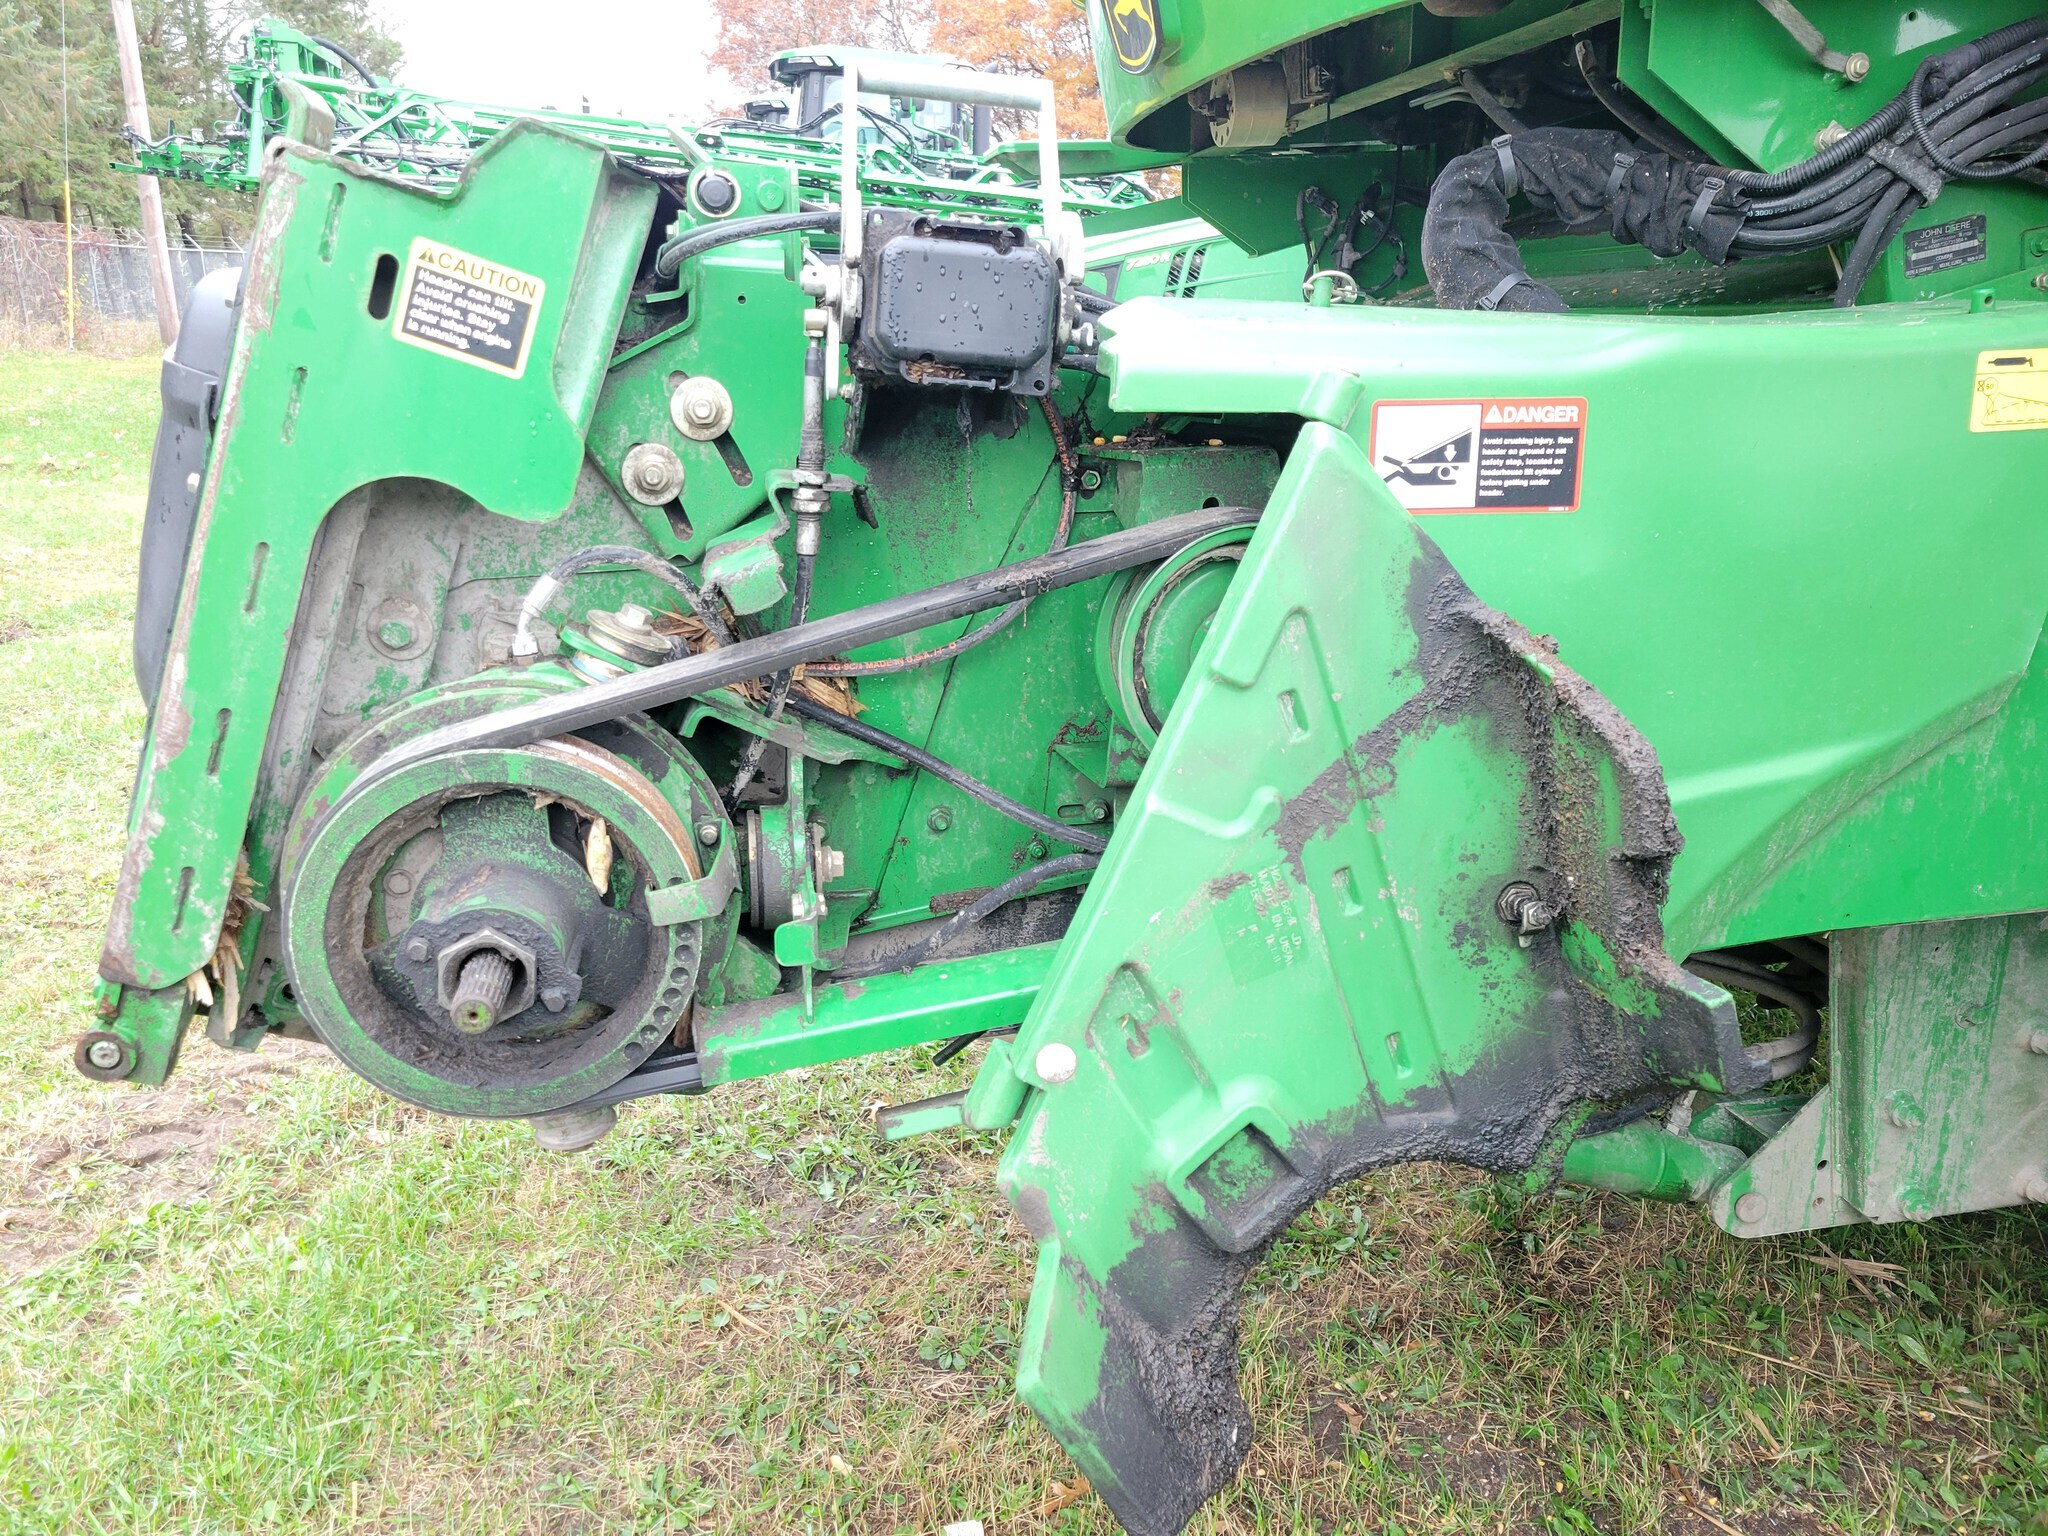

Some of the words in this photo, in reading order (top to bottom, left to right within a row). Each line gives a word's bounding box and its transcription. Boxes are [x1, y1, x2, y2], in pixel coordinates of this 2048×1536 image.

[1921, 228, 1942, 238] JOHN
[438, 253, 536, 298] CAUTION
[418, 270, 465, 294] Header
[467, 288, 491, 303] can
[415, 283, 454, 303] Avoid
[455, 297, 510, 325] crushing
[466, 312, 496, 332] Stay
[439, 318, 472, 336] when
[472, 330, 511, 349] engine
[1503, 405, 1579, 423] DANGER
[1483, 437, 1502, 445] Avoid
[1504, 437, 1532, 446] crushing
[1534, 437, 1554, 446] injury.
[1482, 448, 1507, 456] header
[1519, 448, 1545, 456] ground
[1481, 458, 1504, 467] safety
[1506, 458, 1524, 467] stop,
[1525, 458, 1553, 466] located
[1481, 468, 1523, 476] feederhouse
[1534, 468, 1562, 476] cylinder
[1480, 478, 1502, 486] before
[1504, 478, 1528, 487] getting
[1479, 489, 1504, 497] header.
[866, 659, 893, 668] MADE
